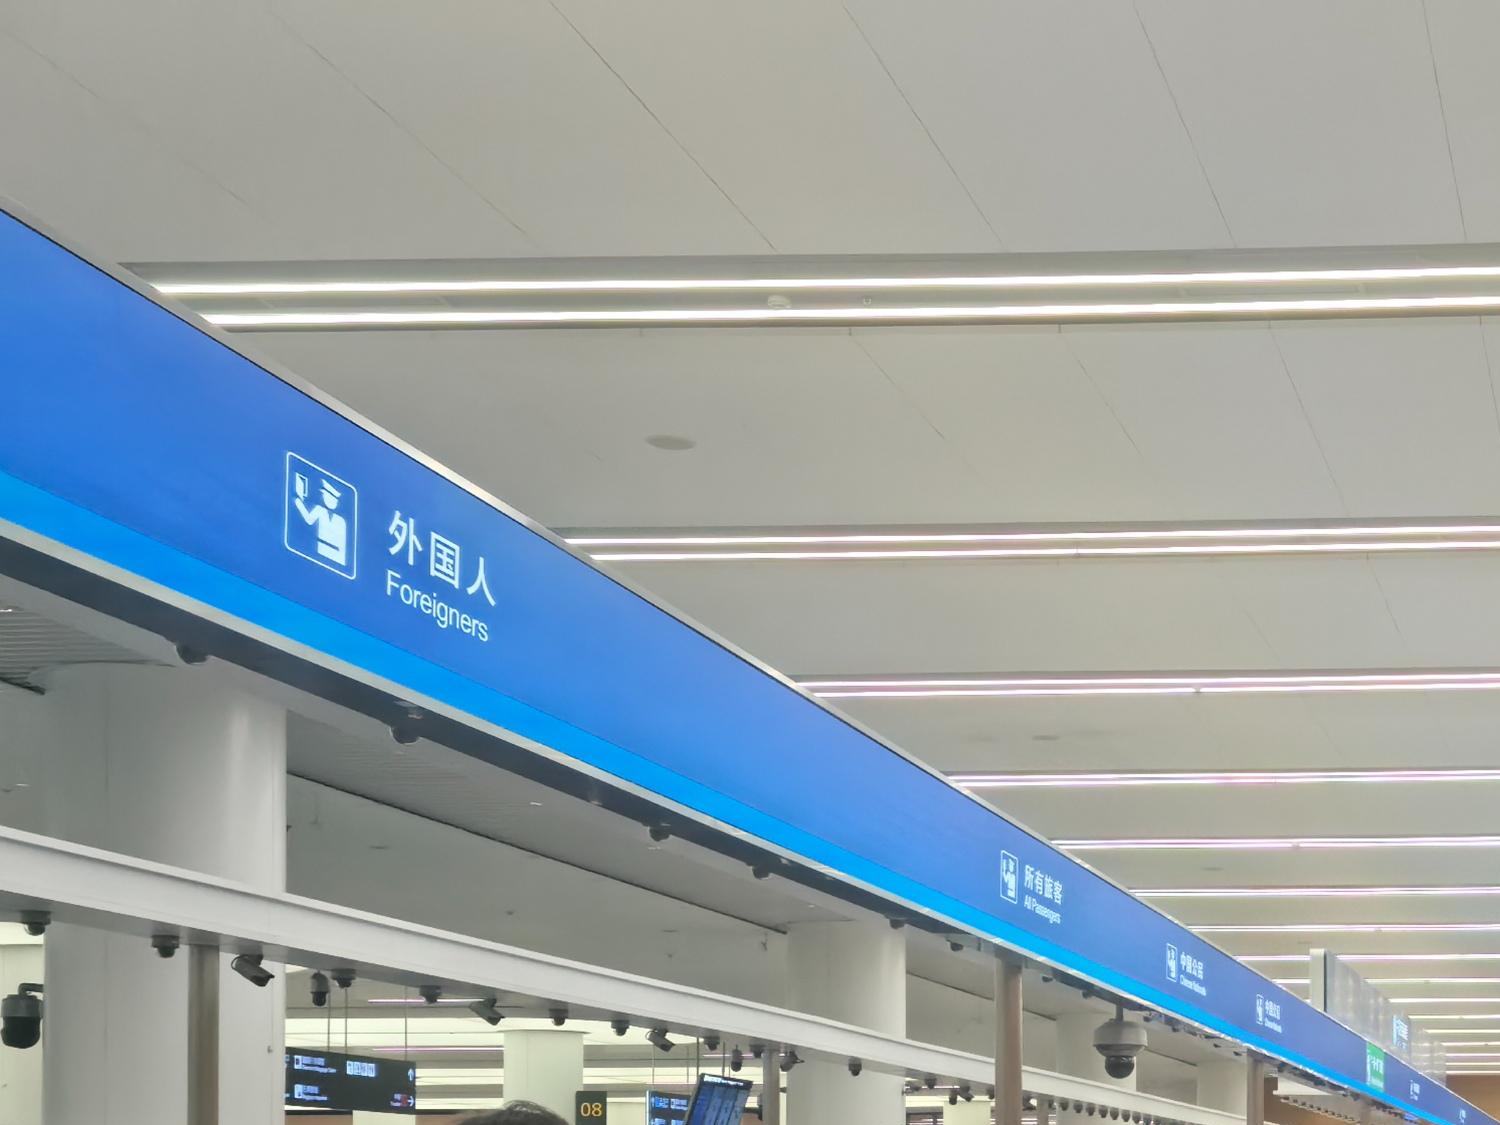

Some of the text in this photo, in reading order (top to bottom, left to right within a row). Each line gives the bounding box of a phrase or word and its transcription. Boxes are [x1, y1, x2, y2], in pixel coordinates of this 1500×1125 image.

[388, 510, 497, 607] 外国人
[386, 569, 489, 642] Foreigners
[1024, 864, 1063, 905] 所有旅客
[580, 1102, 603, 1117] 08
